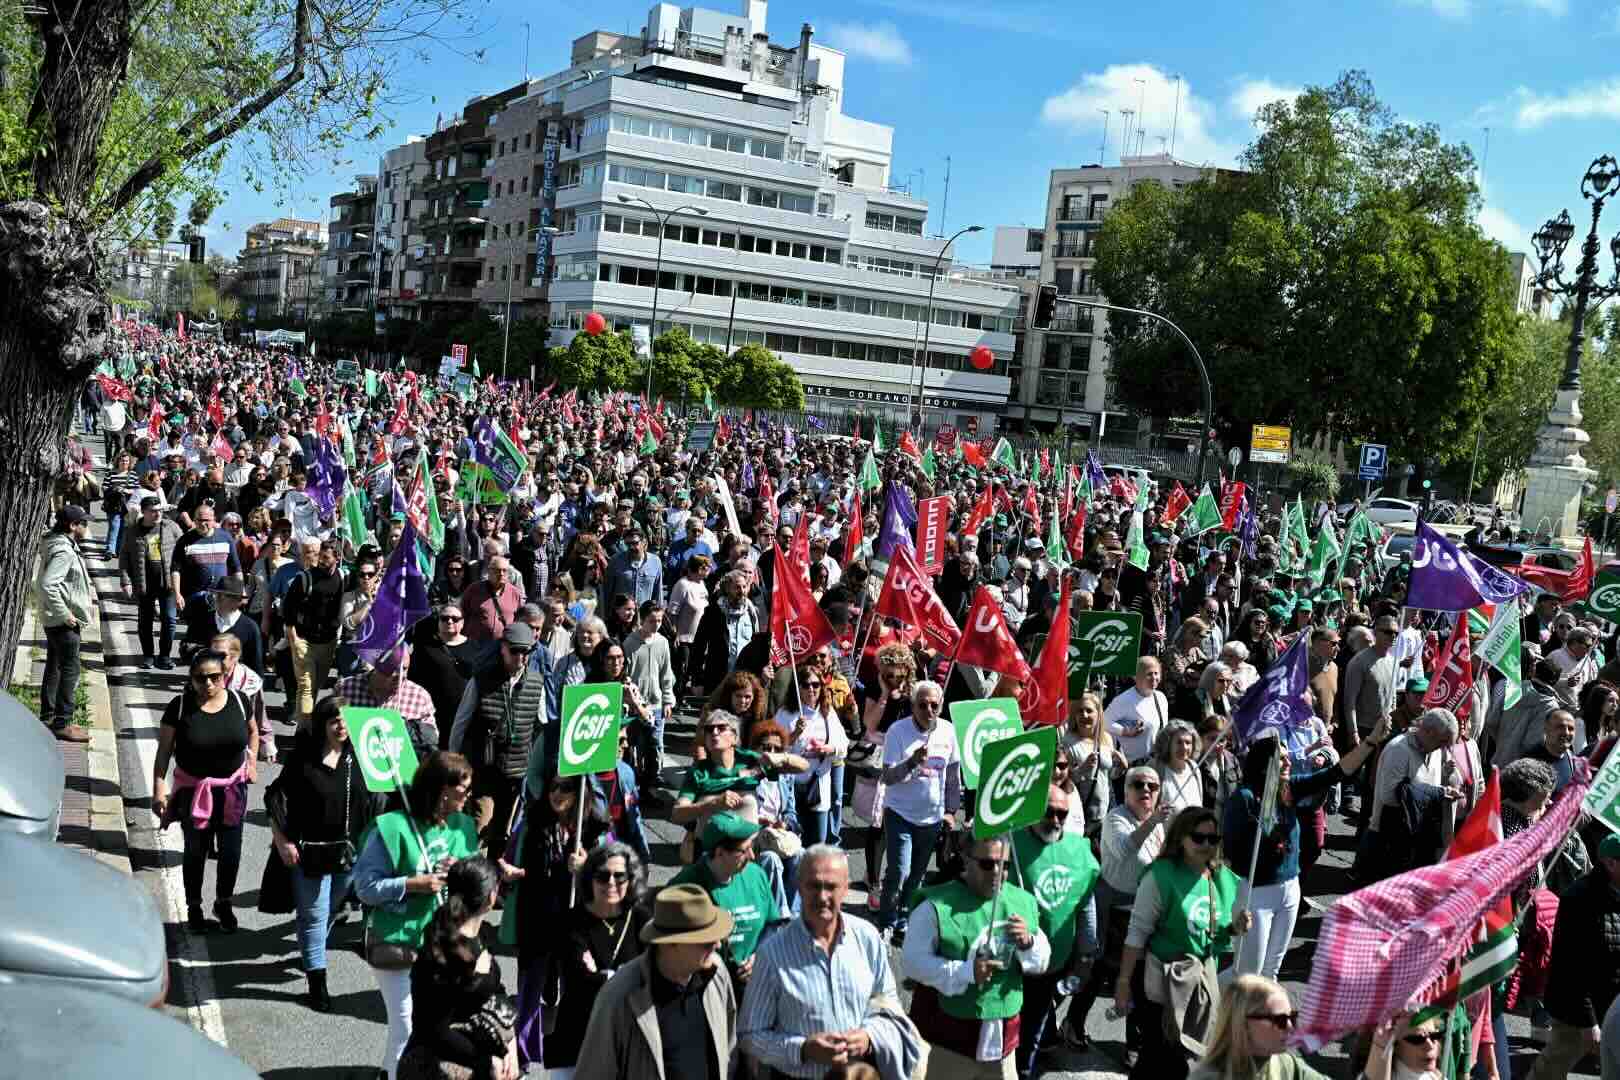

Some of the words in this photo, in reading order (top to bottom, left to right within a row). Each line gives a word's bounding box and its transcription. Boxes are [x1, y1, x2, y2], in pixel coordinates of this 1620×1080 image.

[543, 151, 556, 199] HOTEL
[849, 390, 909, 403] COREANO
[924, 398, 960, 409] MOON
[1365, 447, 1381, 465] P
[925, 500, 940, 553] CCOO
